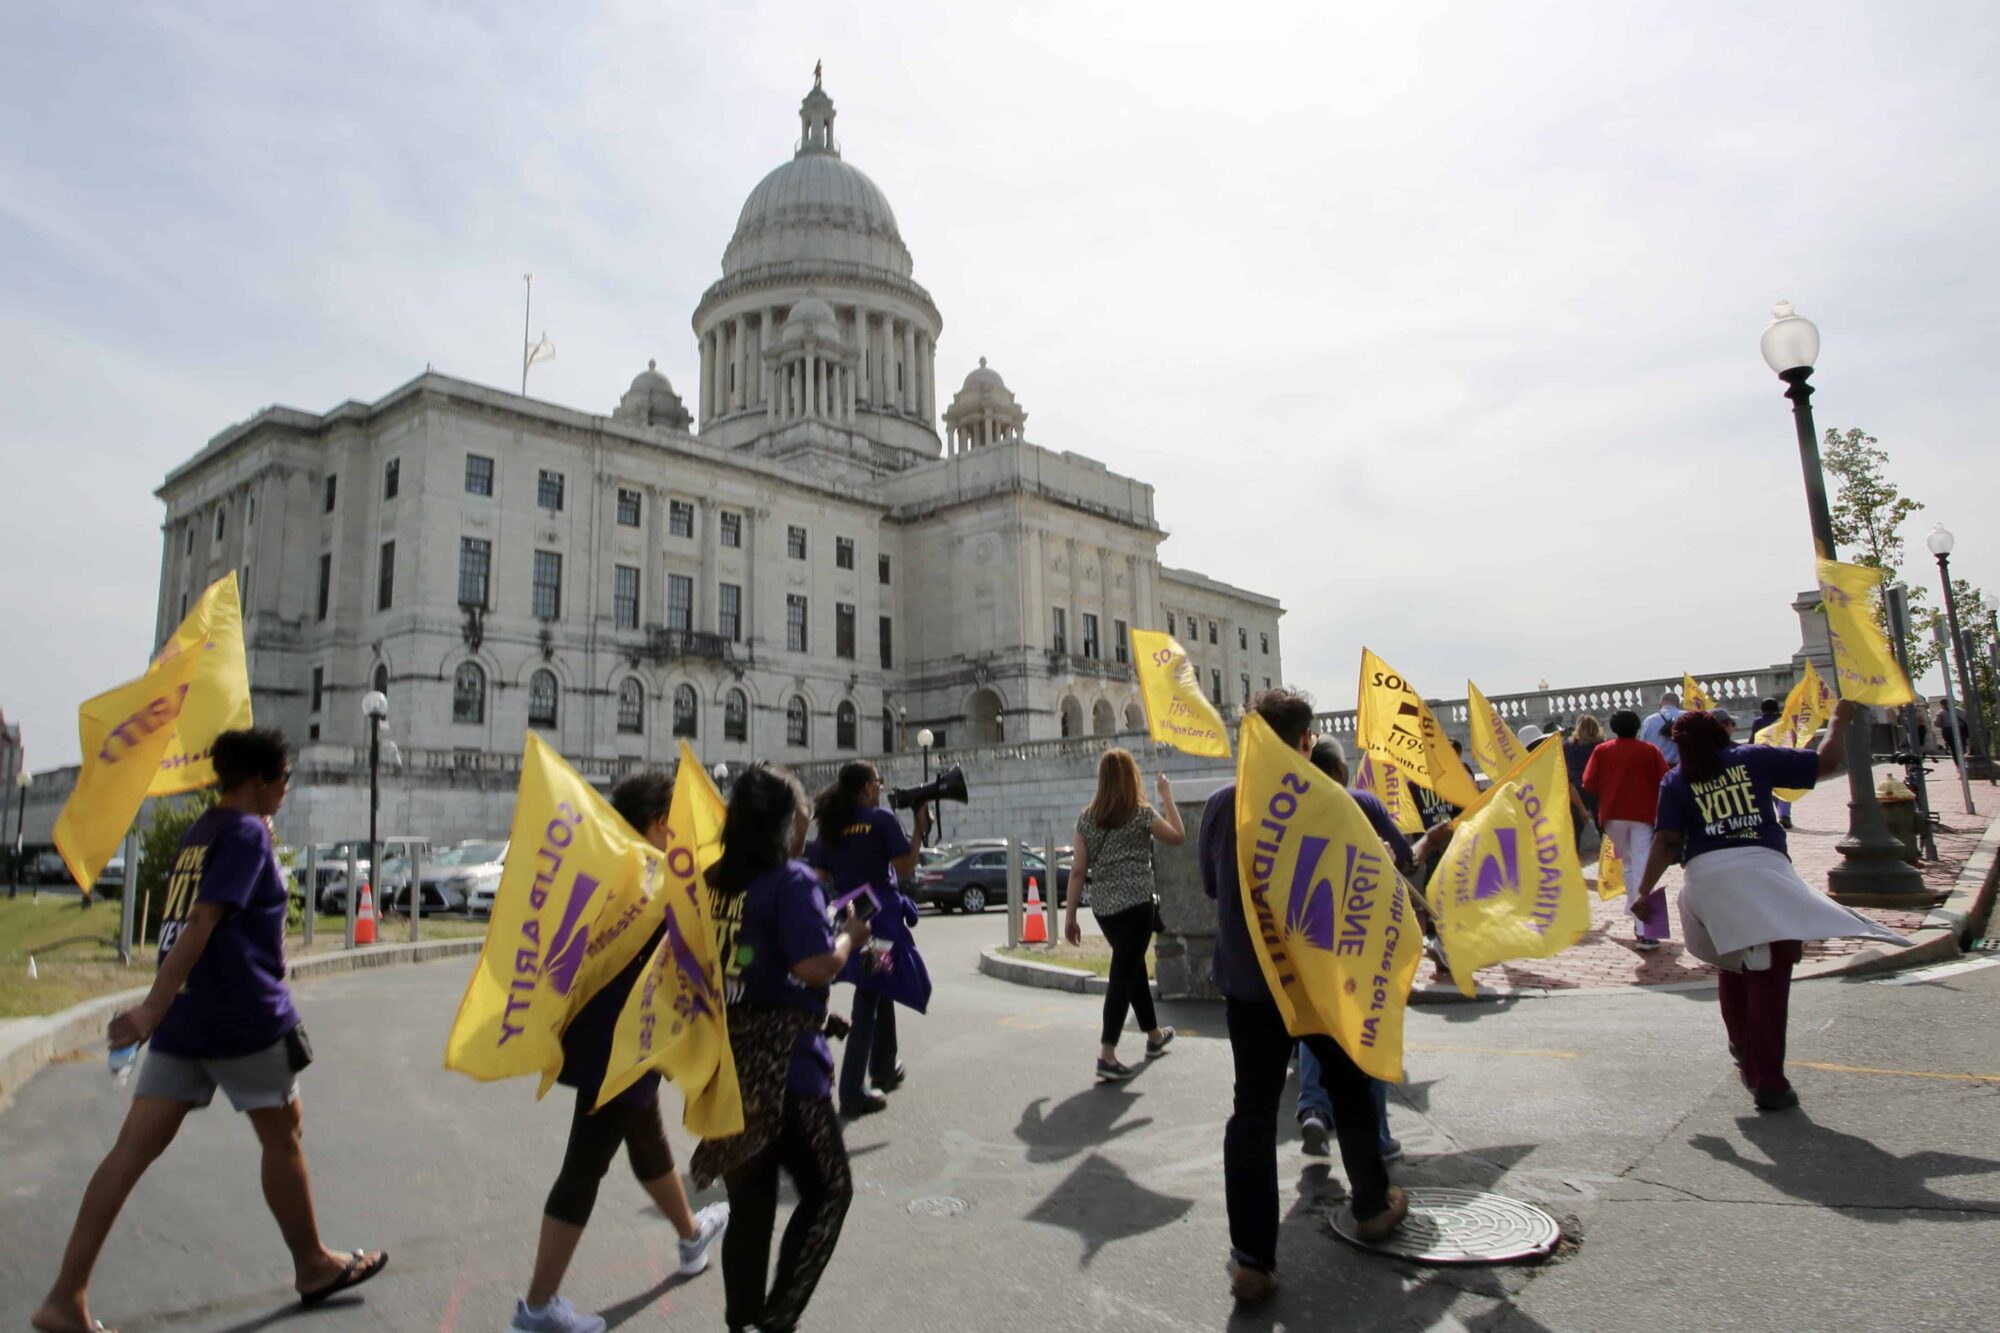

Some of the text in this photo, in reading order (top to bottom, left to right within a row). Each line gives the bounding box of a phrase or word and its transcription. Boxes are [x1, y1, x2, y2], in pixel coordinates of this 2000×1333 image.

[1725, 764, 1751, 784] WE
[1694, 781, 1760, 824] VOTE
[1704, 820, 1727, 836] WE
[1516, 783, 1563, 938] SOLIDARITY
